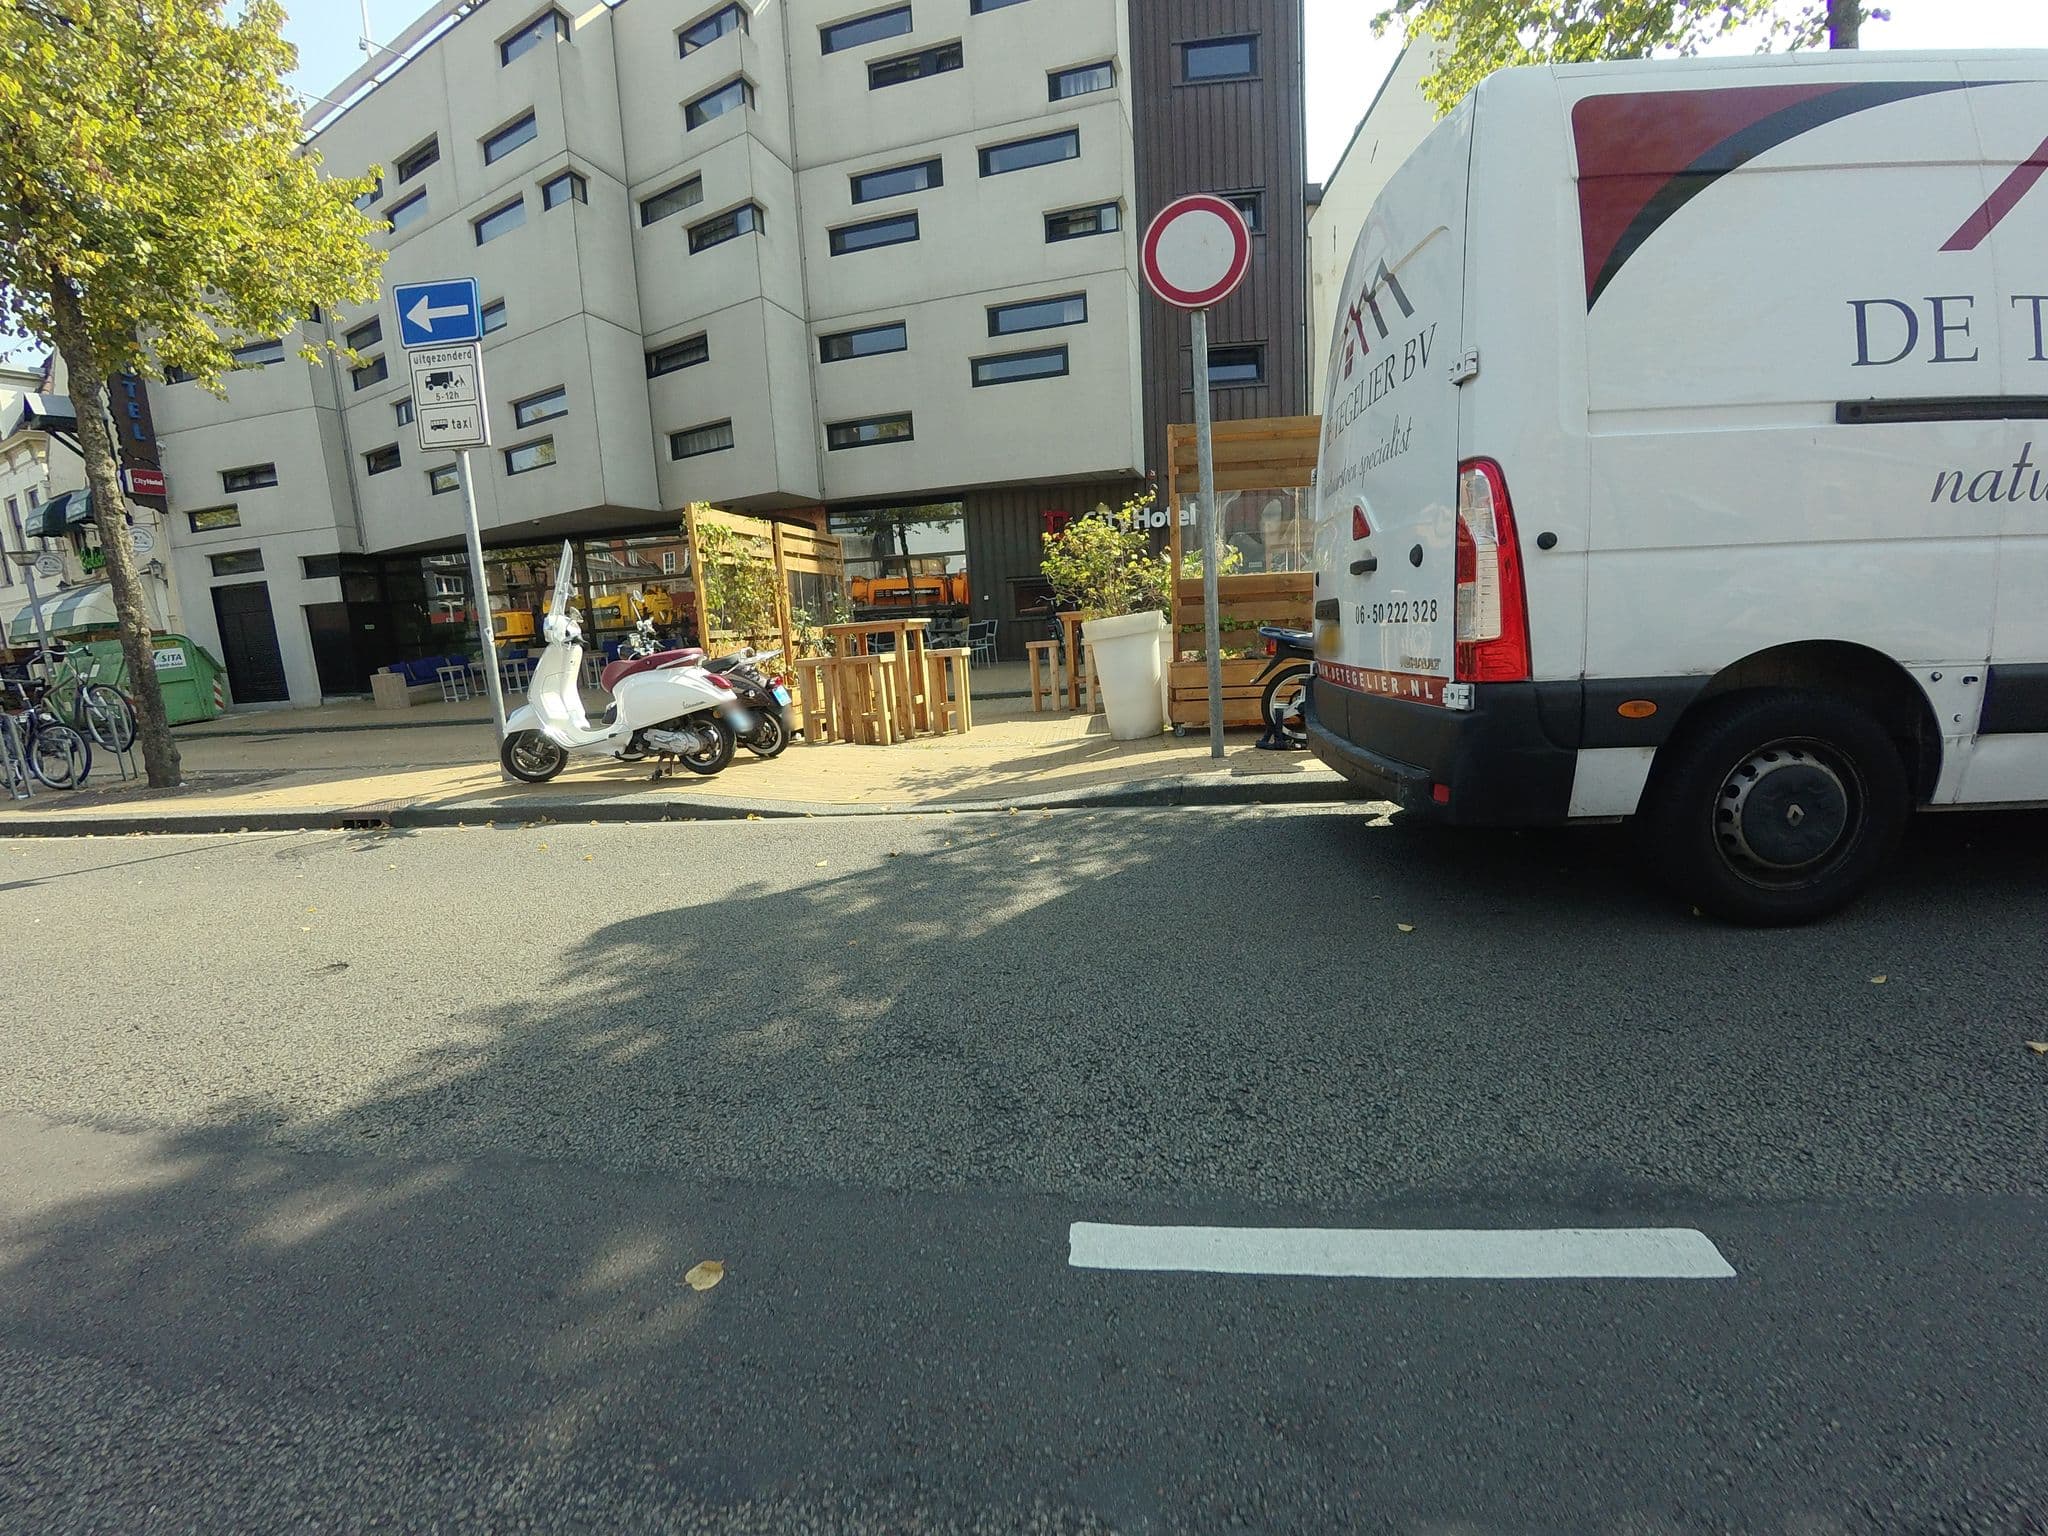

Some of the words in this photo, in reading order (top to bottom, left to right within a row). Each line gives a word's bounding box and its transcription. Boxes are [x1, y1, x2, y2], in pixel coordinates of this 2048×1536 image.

[1846, 295, 1978, 366] DE
[413, 350, 472, 366] uitgezonderd
[1335, 353, 1396, 440] TEGELIER
[1402, 323, 1437, 382] BV
[435, 391, 460, 401] 5-12h
[452, 416, 472, 429] taxi
[1359, 413, 1413, 489] specialist
[1930, 441, 2048, 503] natu
[1081, 509, 1130, 536] Cty
[1387, 601, 1408, 623] 222
[1412, 599, 1437, 623] 328
[162, 653, 183, 663] SITA
[1400, 655, 1441, 670] NAULT
